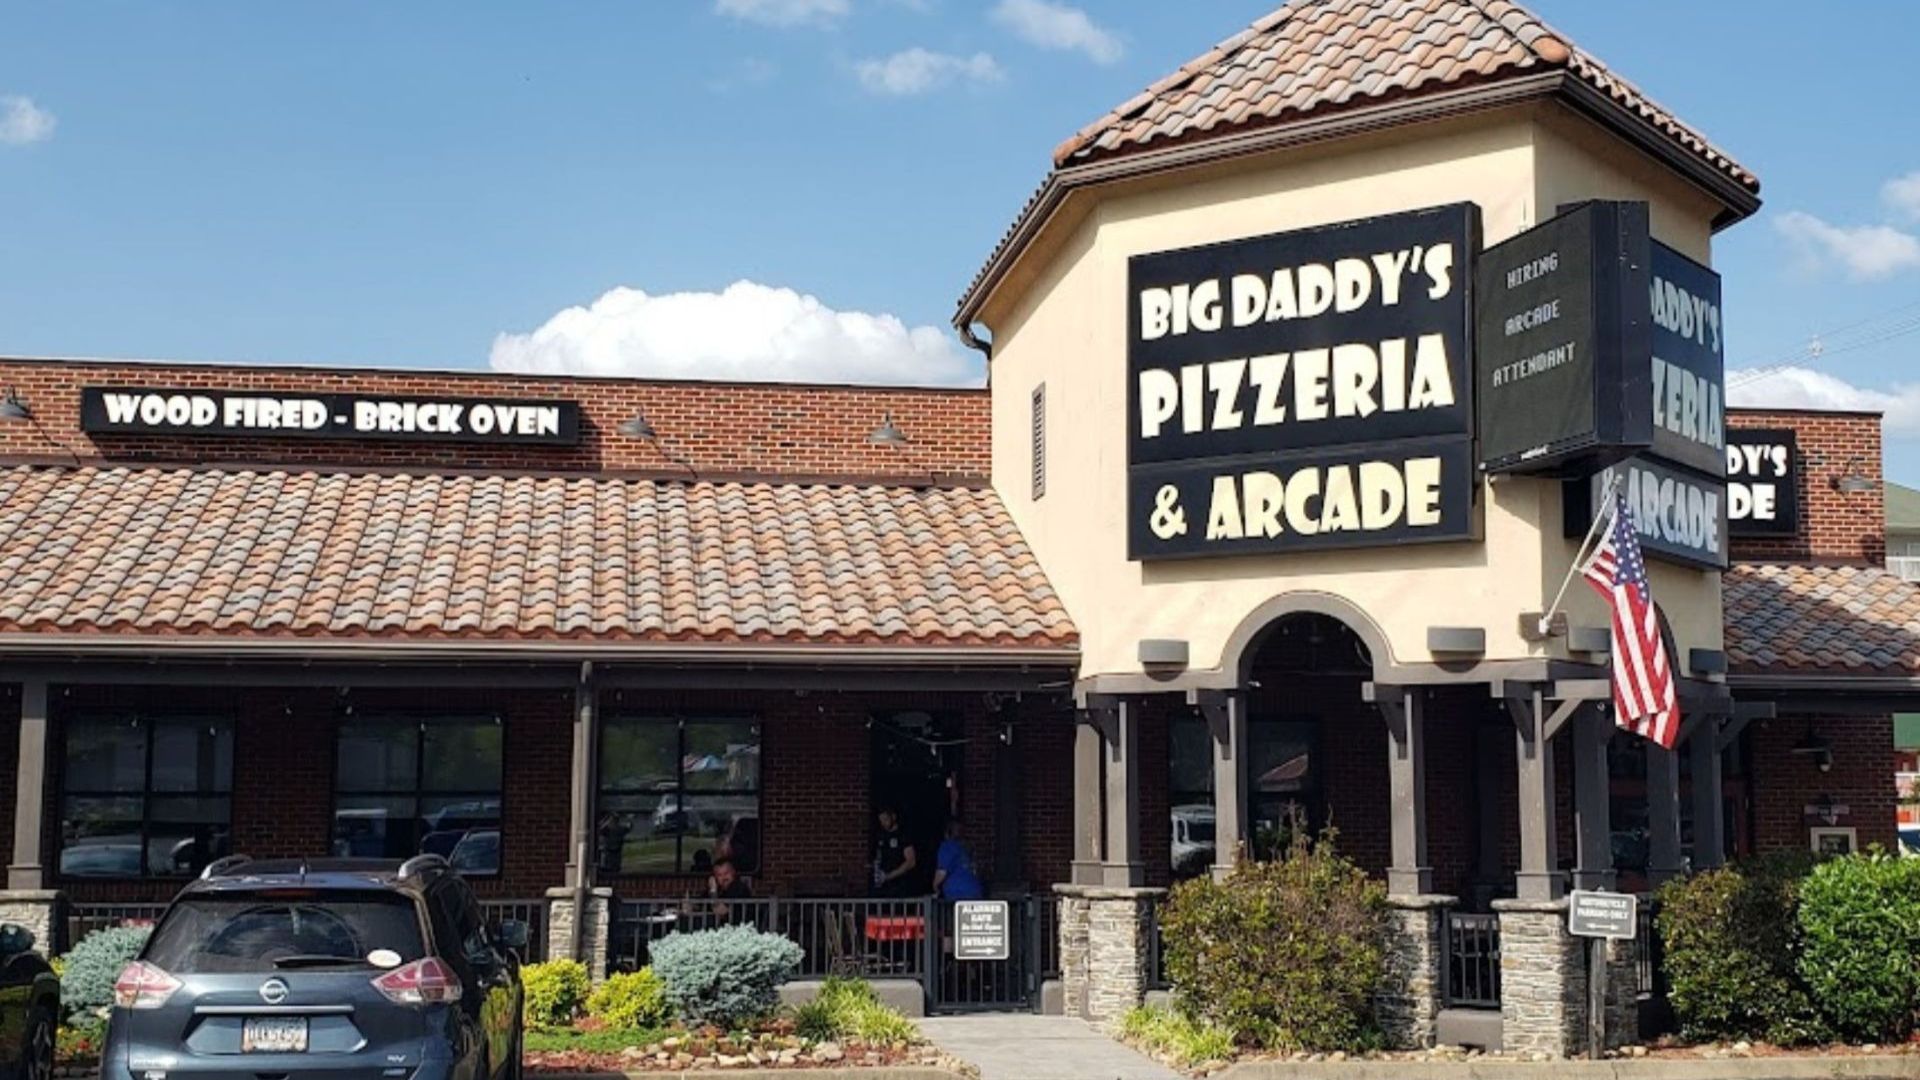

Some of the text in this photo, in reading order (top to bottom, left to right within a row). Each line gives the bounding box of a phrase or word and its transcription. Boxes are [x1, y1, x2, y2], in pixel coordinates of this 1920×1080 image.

[1141, 243, 1453, 340] BIG DADDY'S
[1506, 252, 1559, 289] HIRING
[1505, 299, 1560, 336] ARCADE
[1649, 276, 1720, 353] ADDY'S
[1140, 333, 1455, 438] PIZZERIA
[1493, 341, 1576, 387] ATTENDANT
[103, 393, 217, 426] WOOD
[223, 397, 328, 430] FIRED
[354, 401, 464, 434] BRICK
[469, 404, 560, 436] OVEN
[1150, 456, 1442, 541] & ARCADE
[1627, 467, 1719, 553] ARCADE
[961, 936, 1003, 947] ENTRANCE
